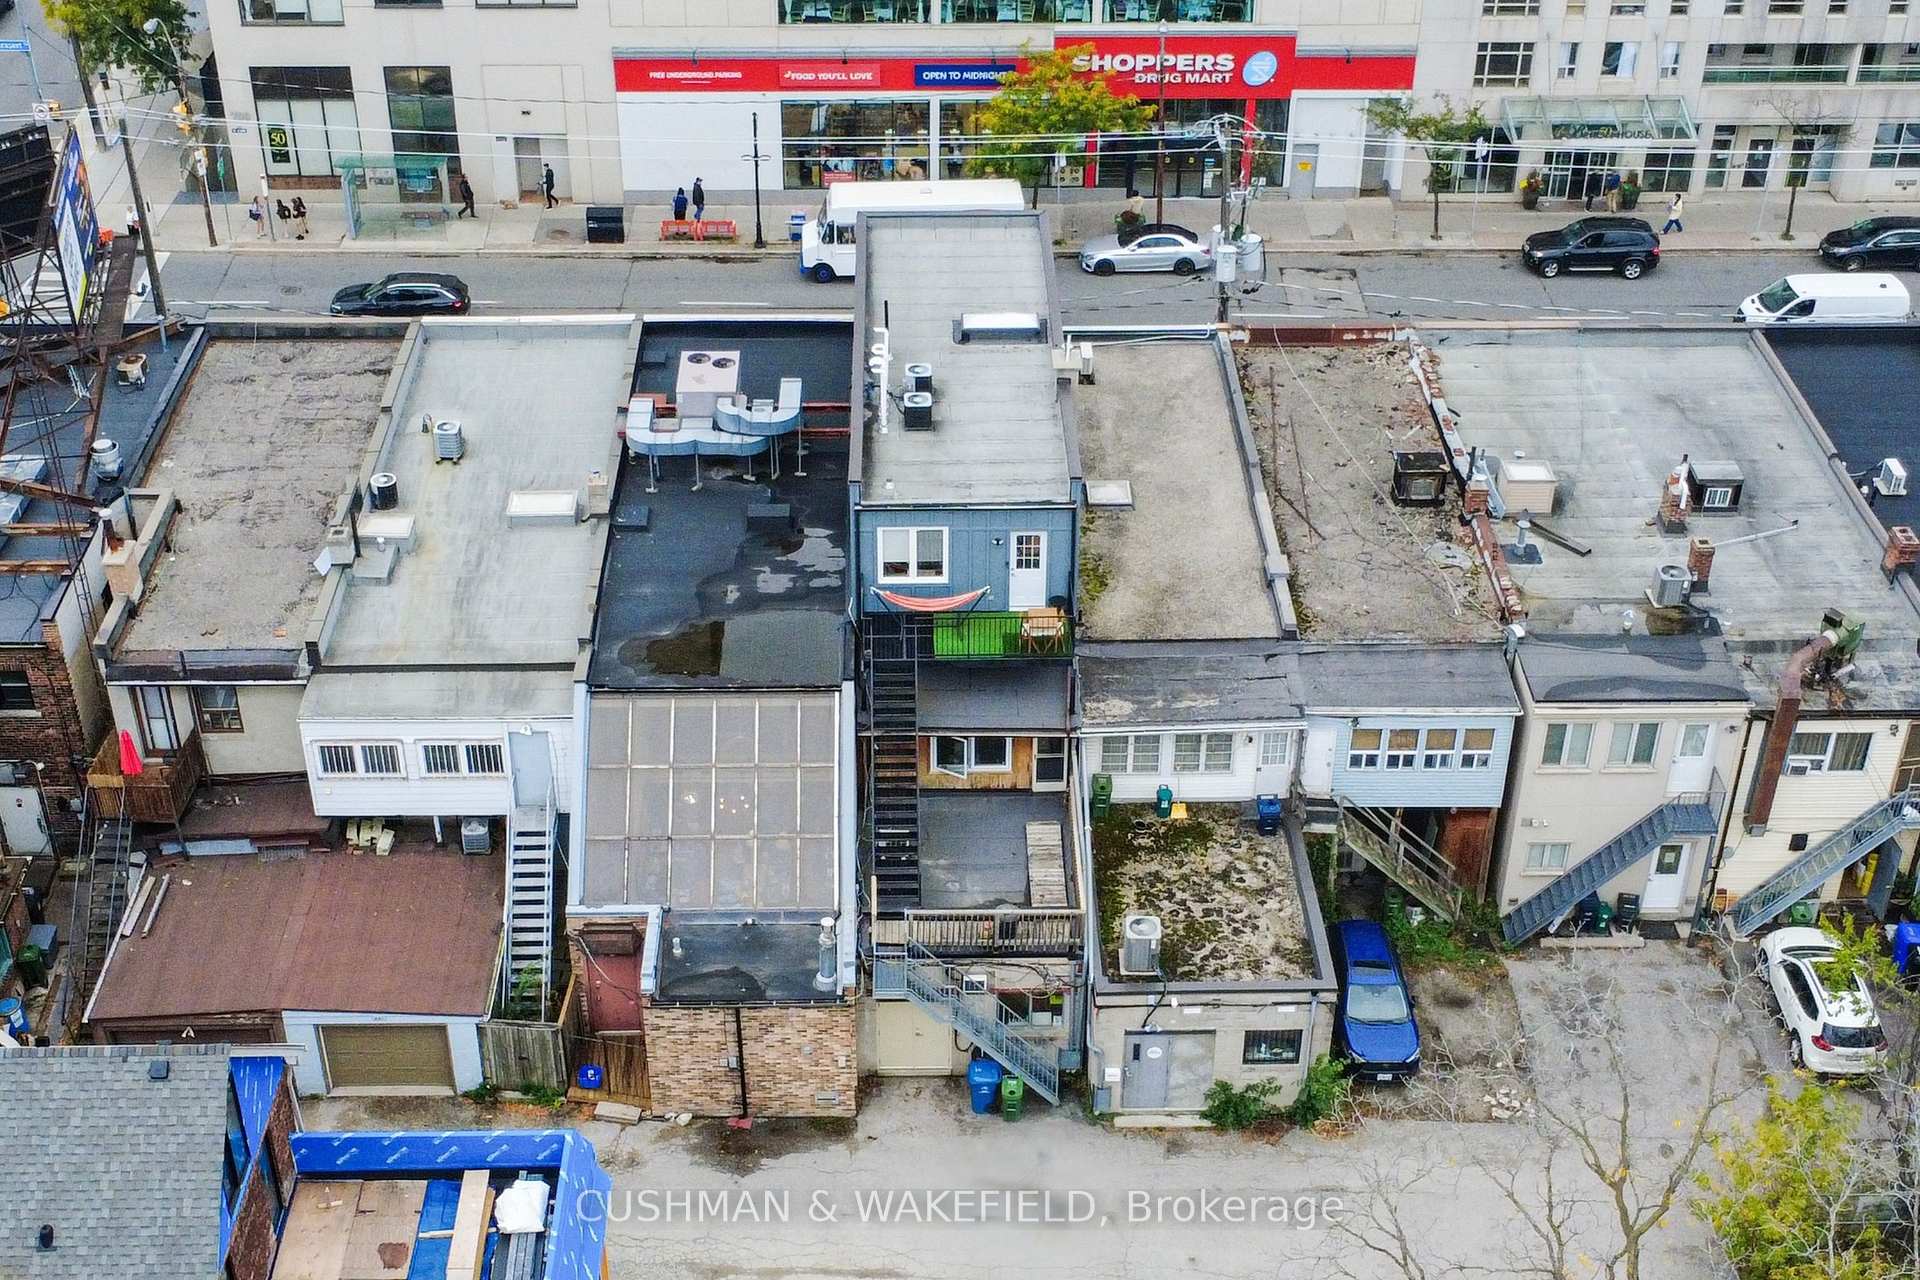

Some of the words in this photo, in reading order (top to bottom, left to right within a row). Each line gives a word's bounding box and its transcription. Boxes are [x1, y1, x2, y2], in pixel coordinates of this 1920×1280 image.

[1072, 54, 1236, 72] SHOPPERS
[649, 71, 665, 79] FREE
[791, 72, 816, 80] FOOD
[849, 72, 873, 80] LOVE
[923, 71, 947, 80] OPEN
[948, 71, 961, 80] TO
[1134, 73, 1182, 84] DRUG
[1185, 73, 1234, 84] MART
[271, 133, 286, 145] 50
